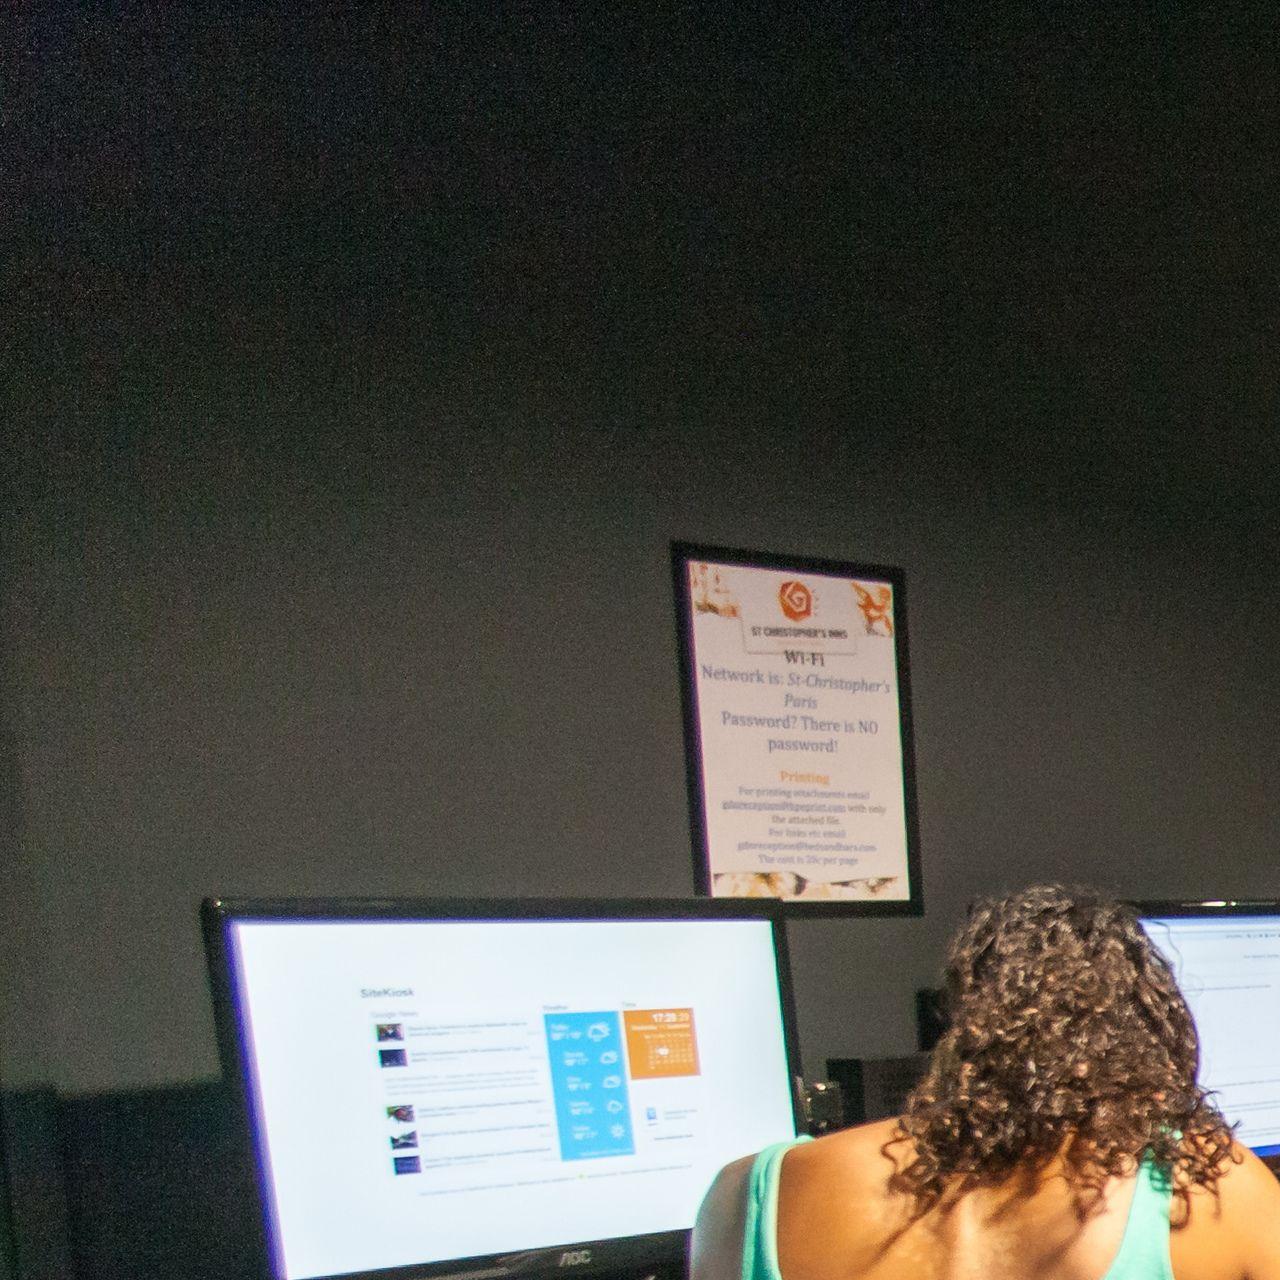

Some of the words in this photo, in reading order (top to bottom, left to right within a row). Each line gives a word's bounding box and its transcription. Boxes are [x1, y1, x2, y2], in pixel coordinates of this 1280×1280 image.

[752, 626, 763, 637] ST
[764, 627, 828, 638] CHRISTOPHER'S
[702, 664, 765, 685] Network
[769, 672, 783, 686] is:
[784, 694, 818, 710] Paris
[721, 710, 798, 731] Password?
[801, 716, 841, 733] There
[844, 720, 855, 733] is
[859, 721, 879, 735] NO
[768, 738, 839, 754] password!
[780, 770, 830, 786] Printing
[756, 786, 792, 799] printing
[360, 987, 415, 999] SiteKiosk
